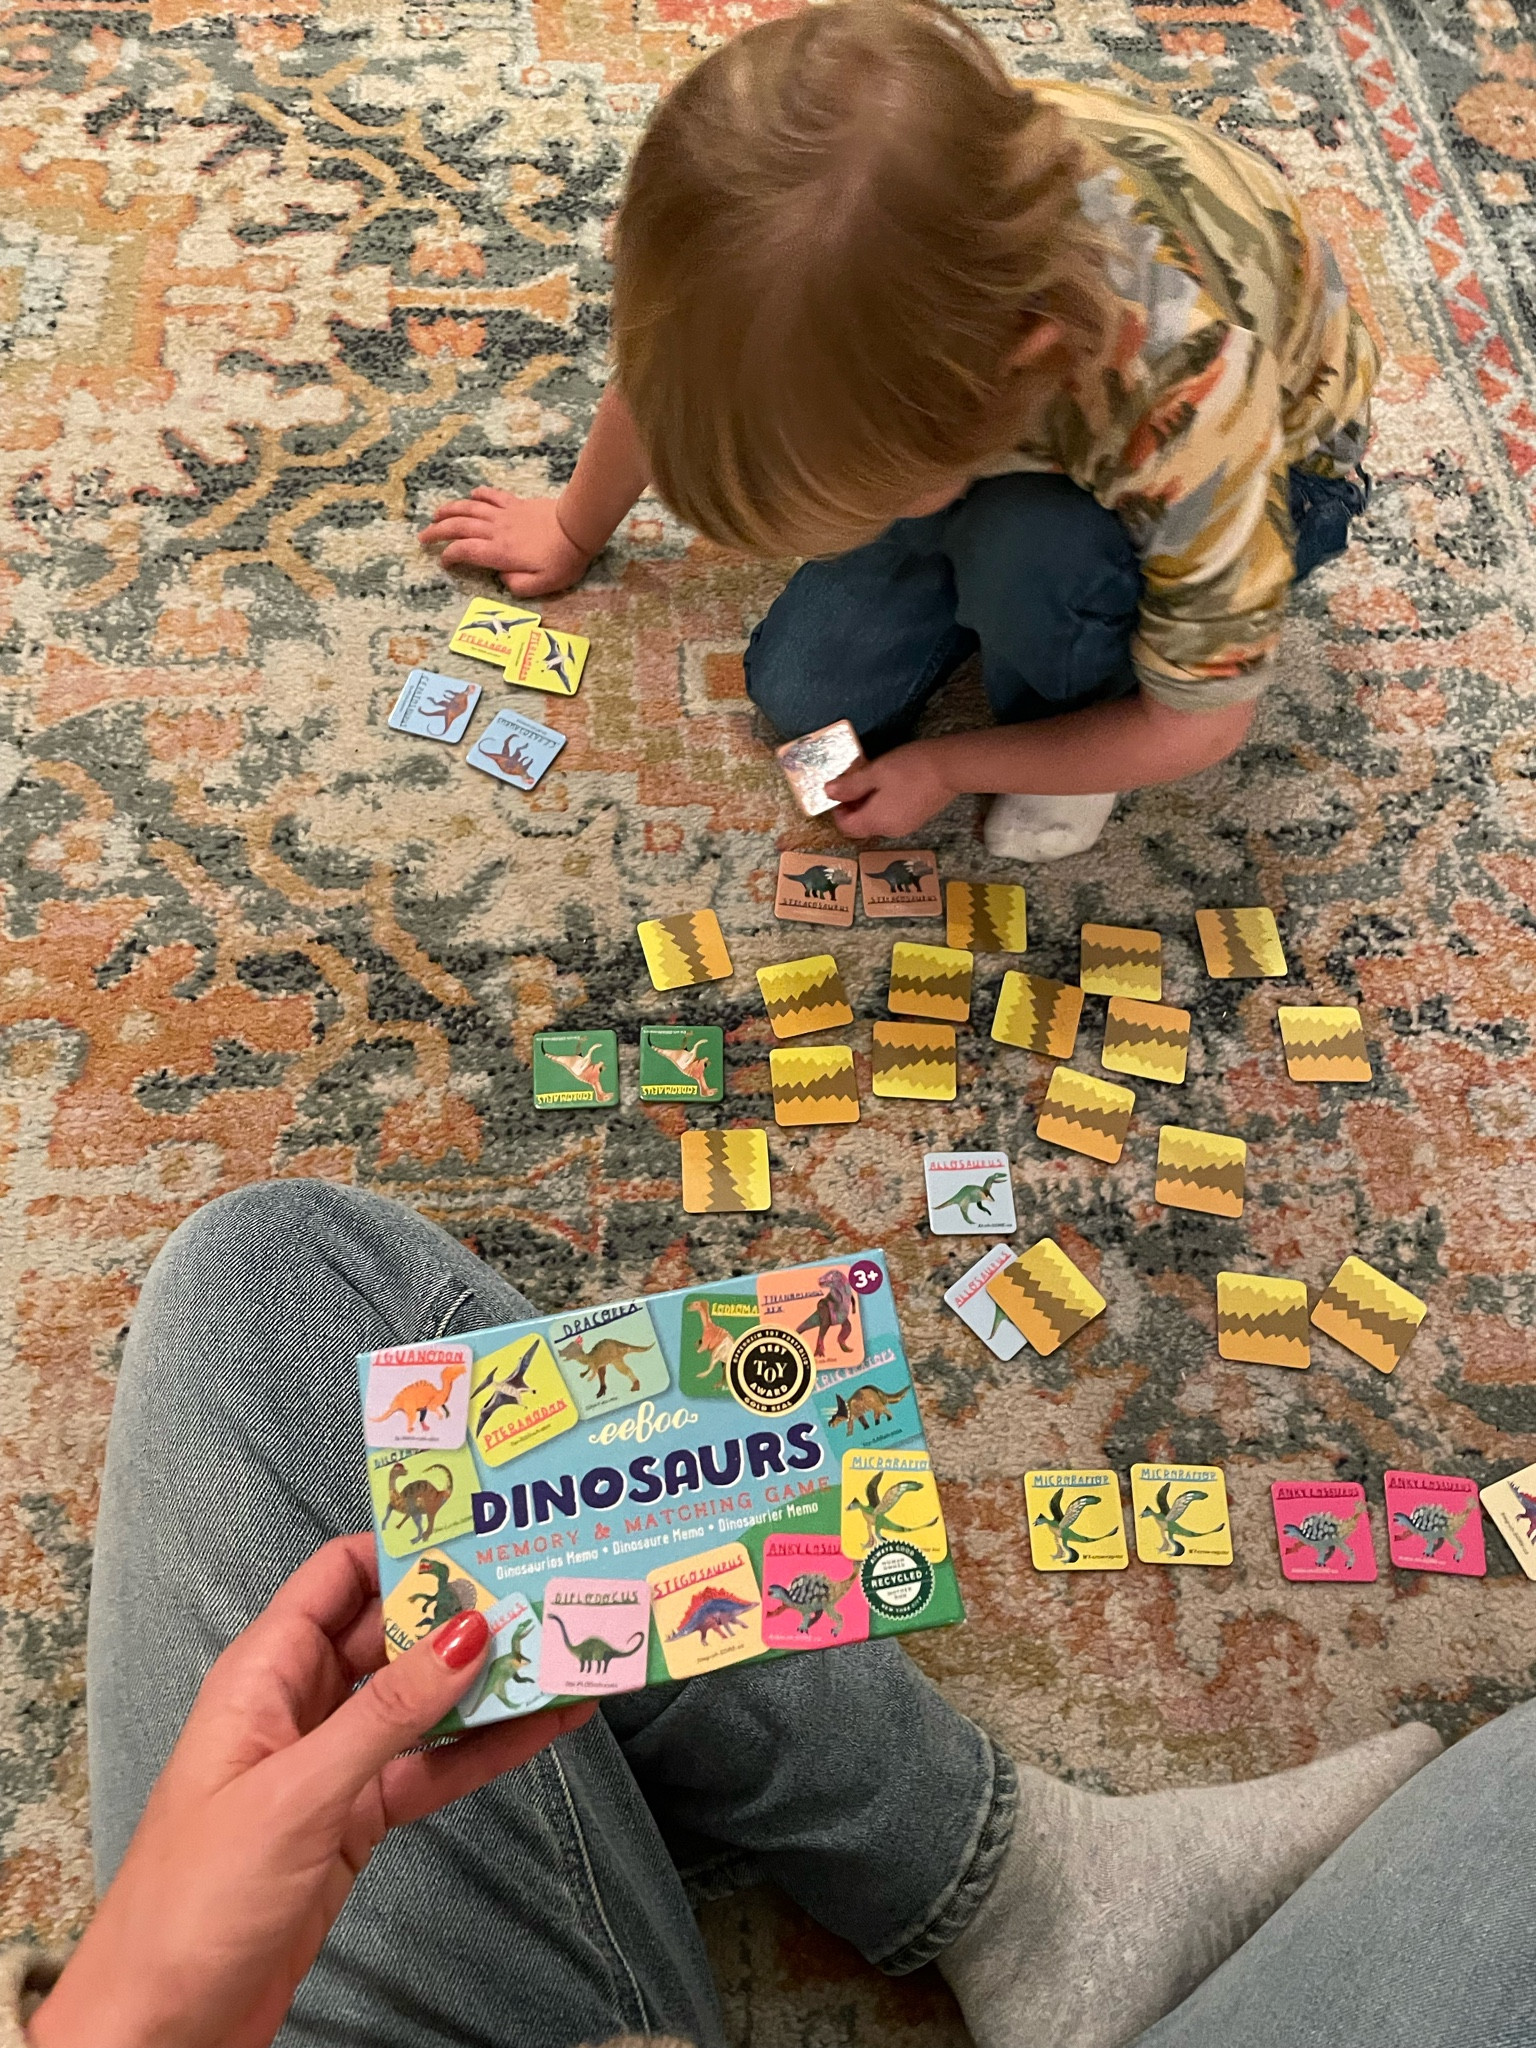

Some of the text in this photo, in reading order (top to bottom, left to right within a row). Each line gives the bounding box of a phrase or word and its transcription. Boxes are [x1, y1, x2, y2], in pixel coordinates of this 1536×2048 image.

[930, 1159, 1004, 1171] ALLOSAURUS
[853, 1269, 879, 1289] 3+
[955, 1251, 1011, 1307] ALLOSAURUS
[760, 1344, 787, 1355] BEST
[753, 1360, 788, 1383] TOY
[749, 1382, 788, 1397] AWARD
[483, 1400, 568, 1449] PTERANODON
[471, 1423, 825, 1537] DINOSAURS
[476, 1476, 833, 1565] MEMORY & MATCHING GAME
[566, 1548, 599, 1566] Memo
[612, 1534, 670, 1556] Dinosaure
[672, 1527, 705, 1543] Memo
[718, 1509, 783, 1532] Dinosaurier
[786, 1502, 819, 1518] Memo
[653, 1554, 745, 1599] STEGOSAURUS
[871, 1570, 923, 1588] RECYCLED
